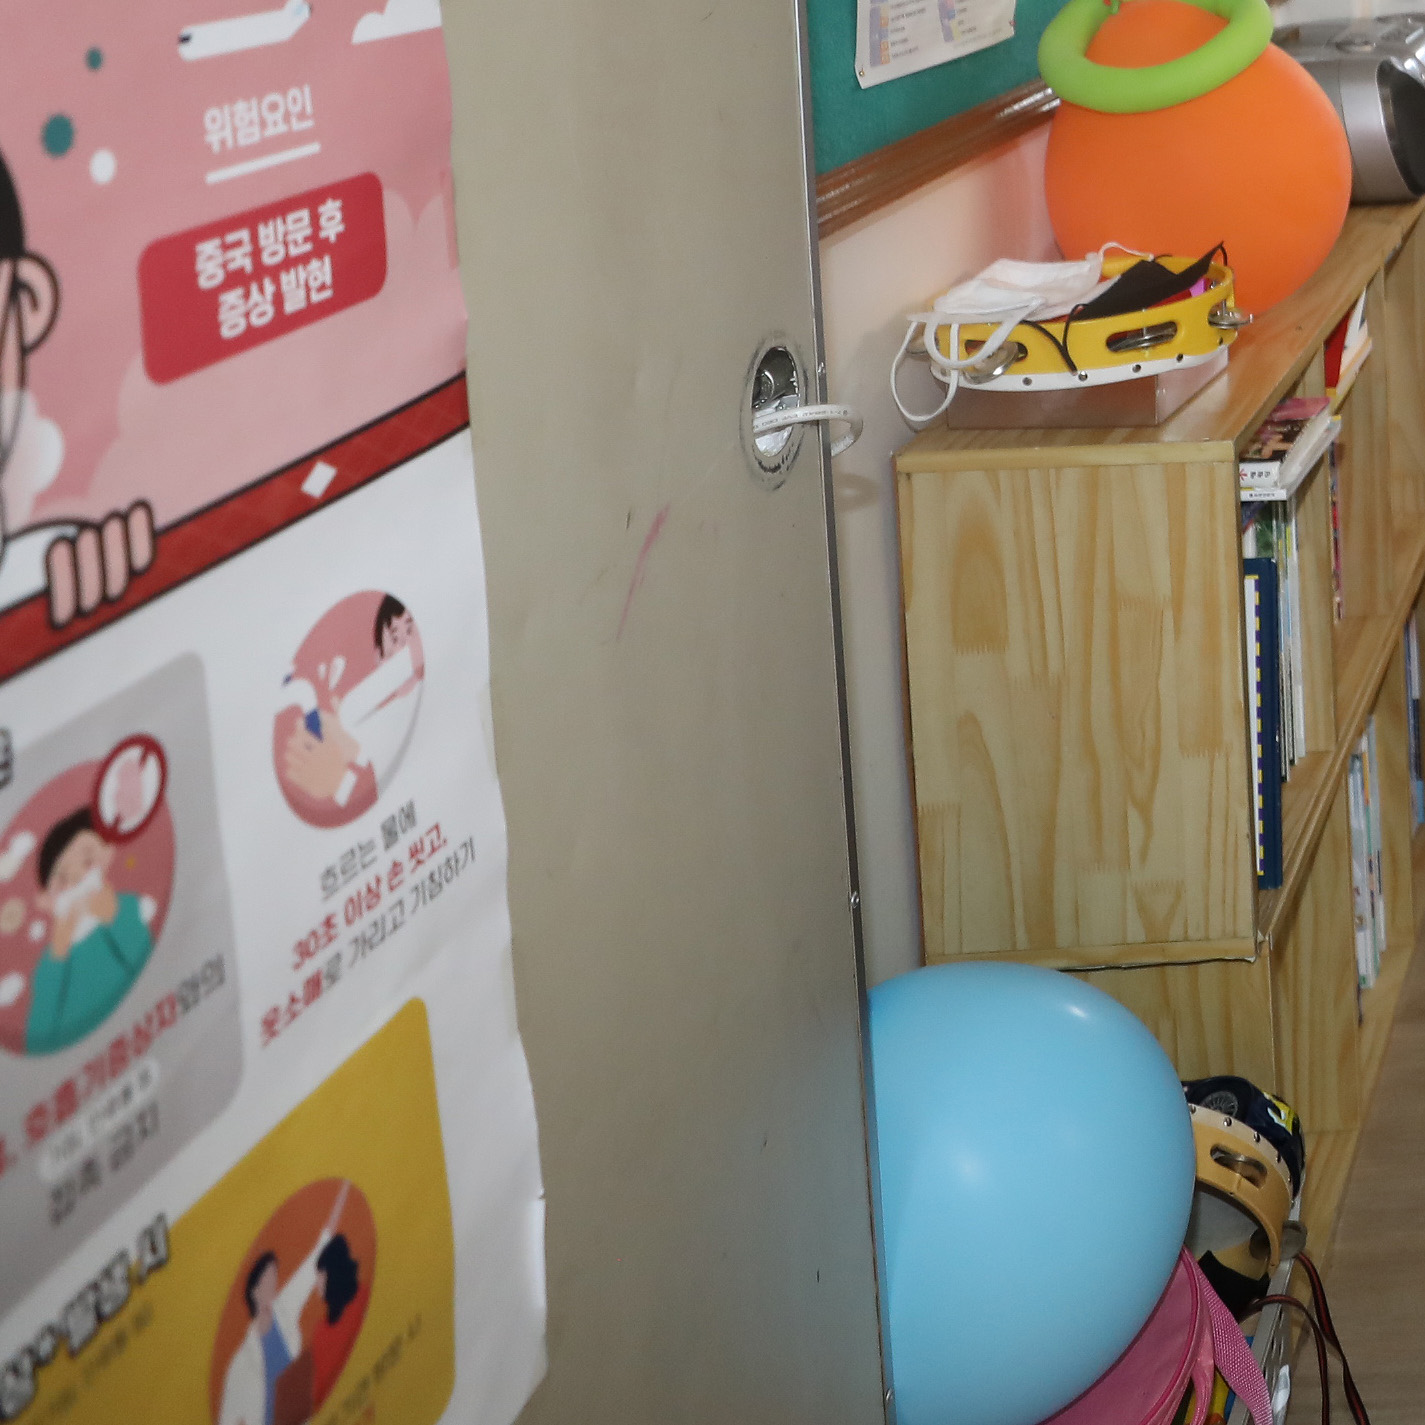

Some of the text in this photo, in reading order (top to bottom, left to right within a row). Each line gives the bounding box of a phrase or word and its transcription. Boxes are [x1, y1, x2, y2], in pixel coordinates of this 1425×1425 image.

[203, 84, 315, 154] 위험요인
[194, 197, 347, 291] 중국 방문 후
[217, 253, 334, 341] 증상 발현
[320, 836, 378, 901] 흐르는
[342, 873, 383, 929] 이상
[386, 859, 405, 895] 손
[348, 897, 406, 970] 가리고
